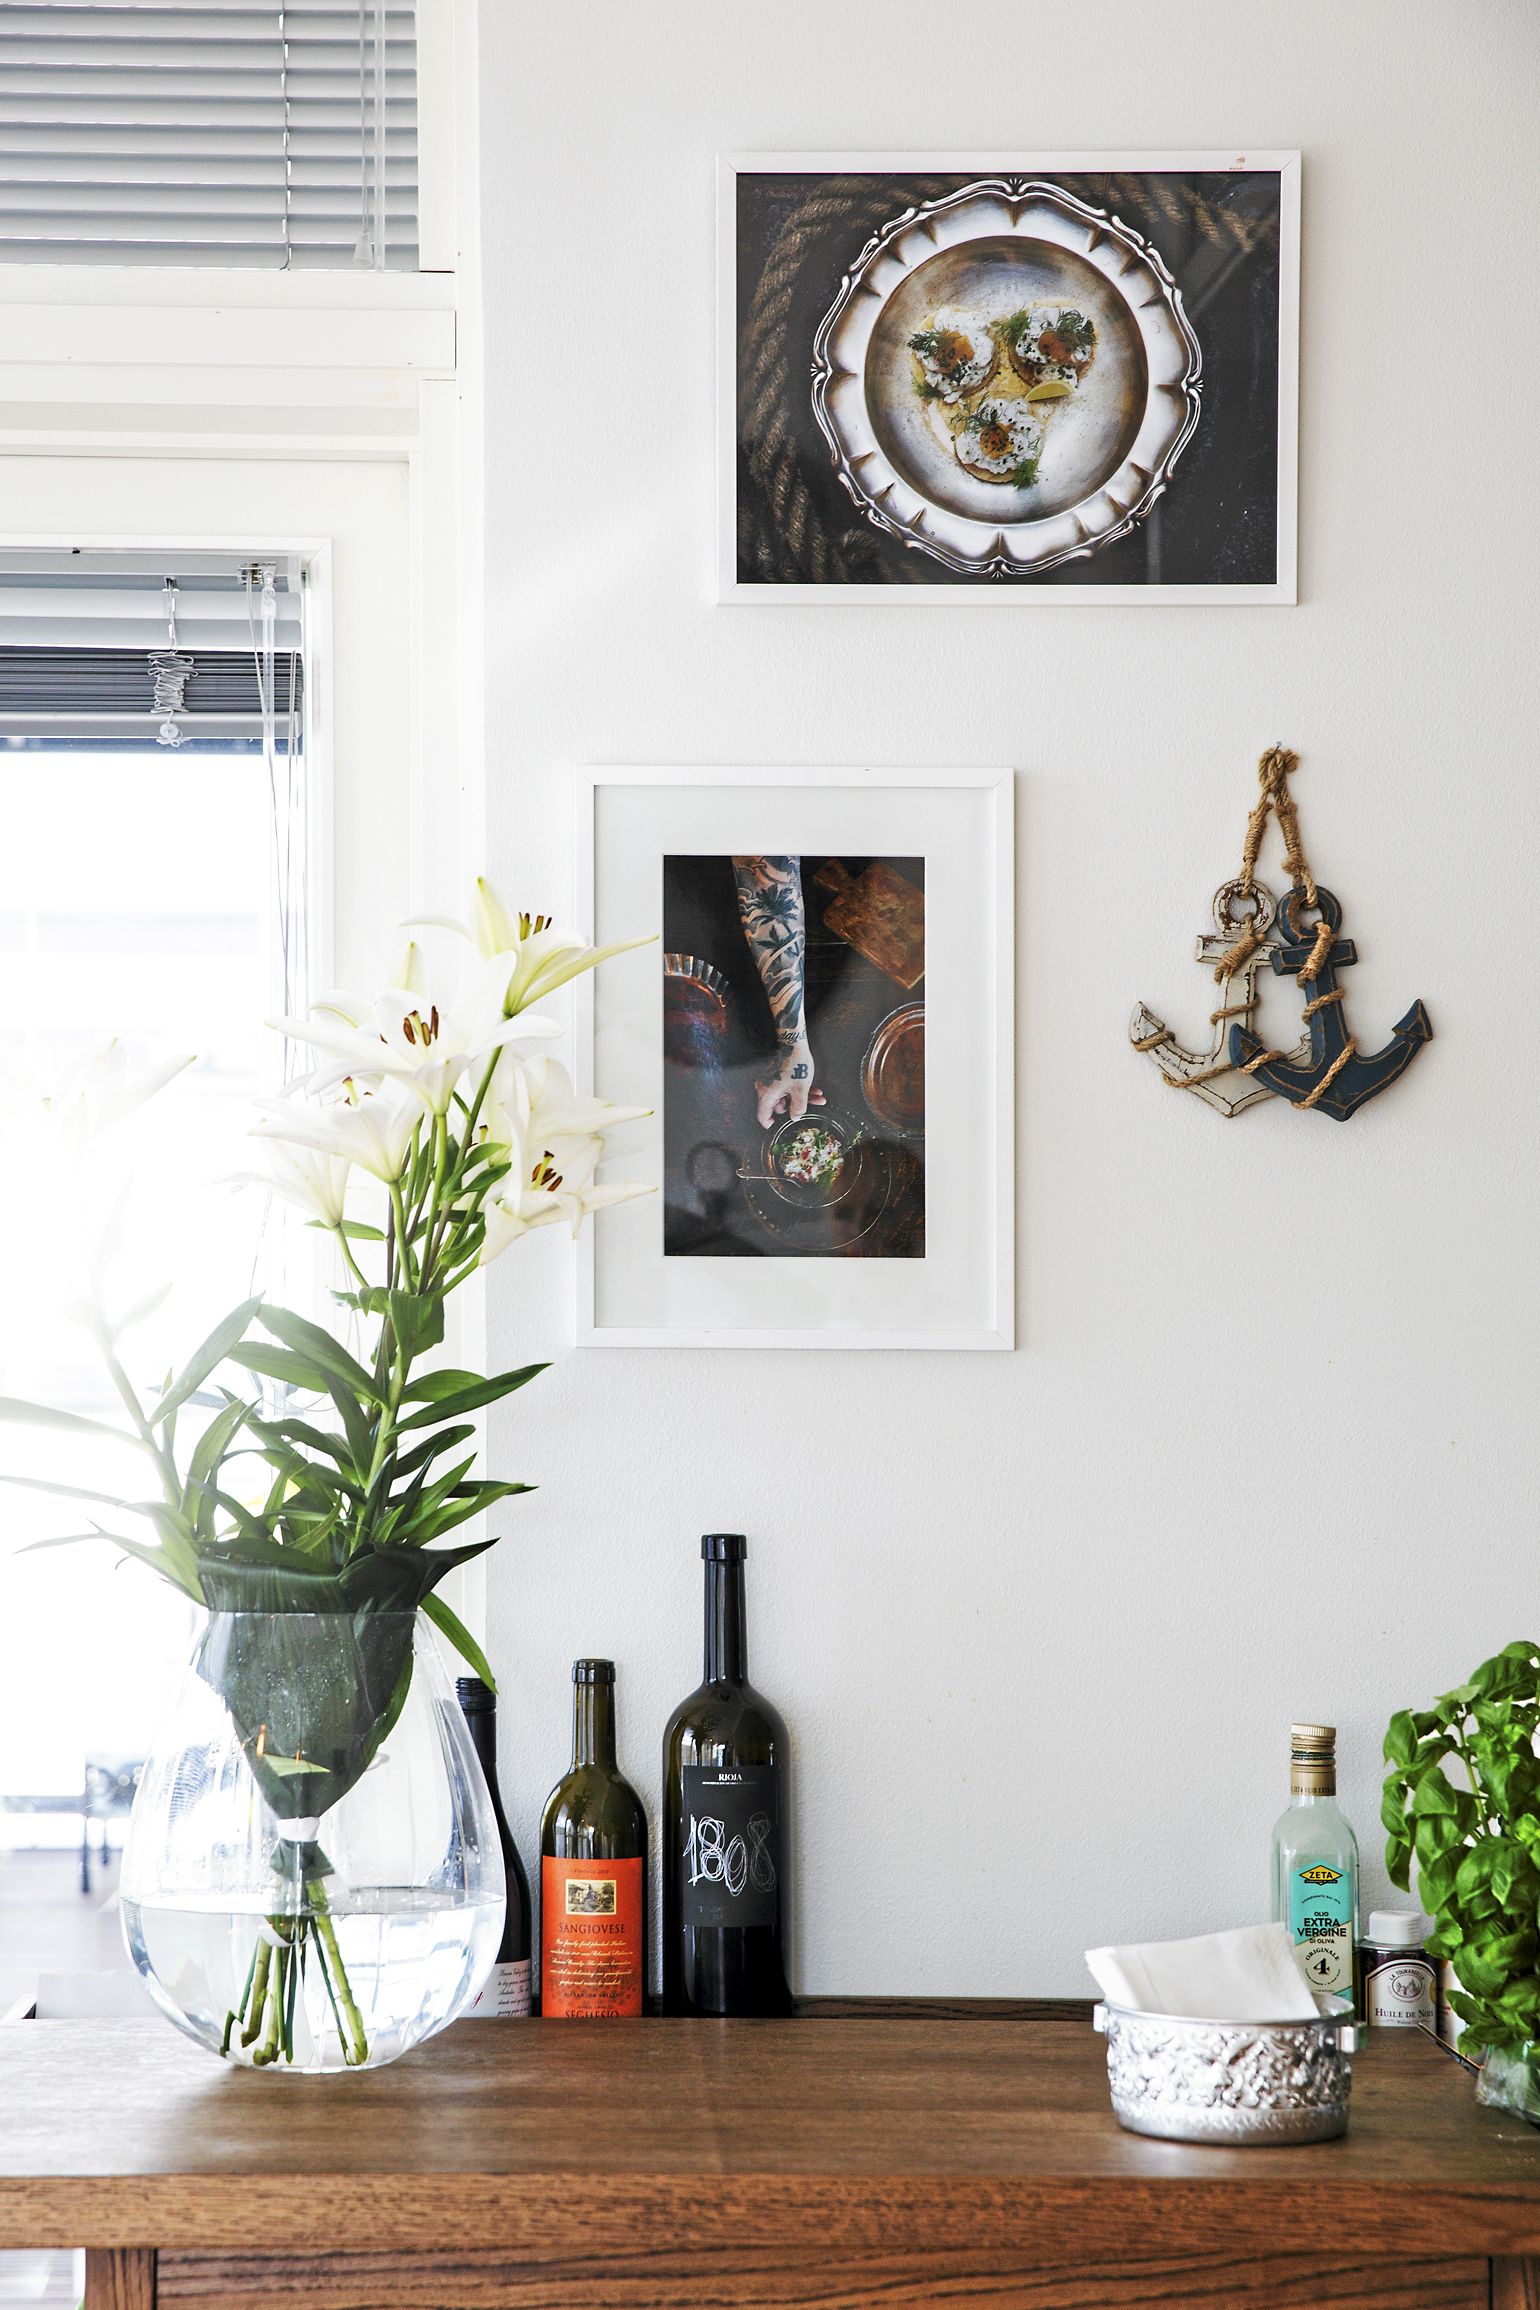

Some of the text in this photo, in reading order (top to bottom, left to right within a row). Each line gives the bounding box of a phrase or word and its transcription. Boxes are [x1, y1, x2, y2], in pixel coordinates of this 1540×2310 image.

[718, 1773, 742, 1781] RIOJA
[683, 1812, 776, 1897] 1808
[1309, 1871, 1333, 1879] ZETA
[559, 1922, 626, 1935] SANGIOVESE
[1303, 1918, 1341, 1928] EXTRA
[1297, 1927, 1347, 1937] VERGINE
[1305, 1947, 1340, 1961] ORIGINALE
[1313, 1957, 1330, 1975] 4
[1375, 2007, 1403, 2018] HUILE
[1406, 2010, 1417, 2018] DE
